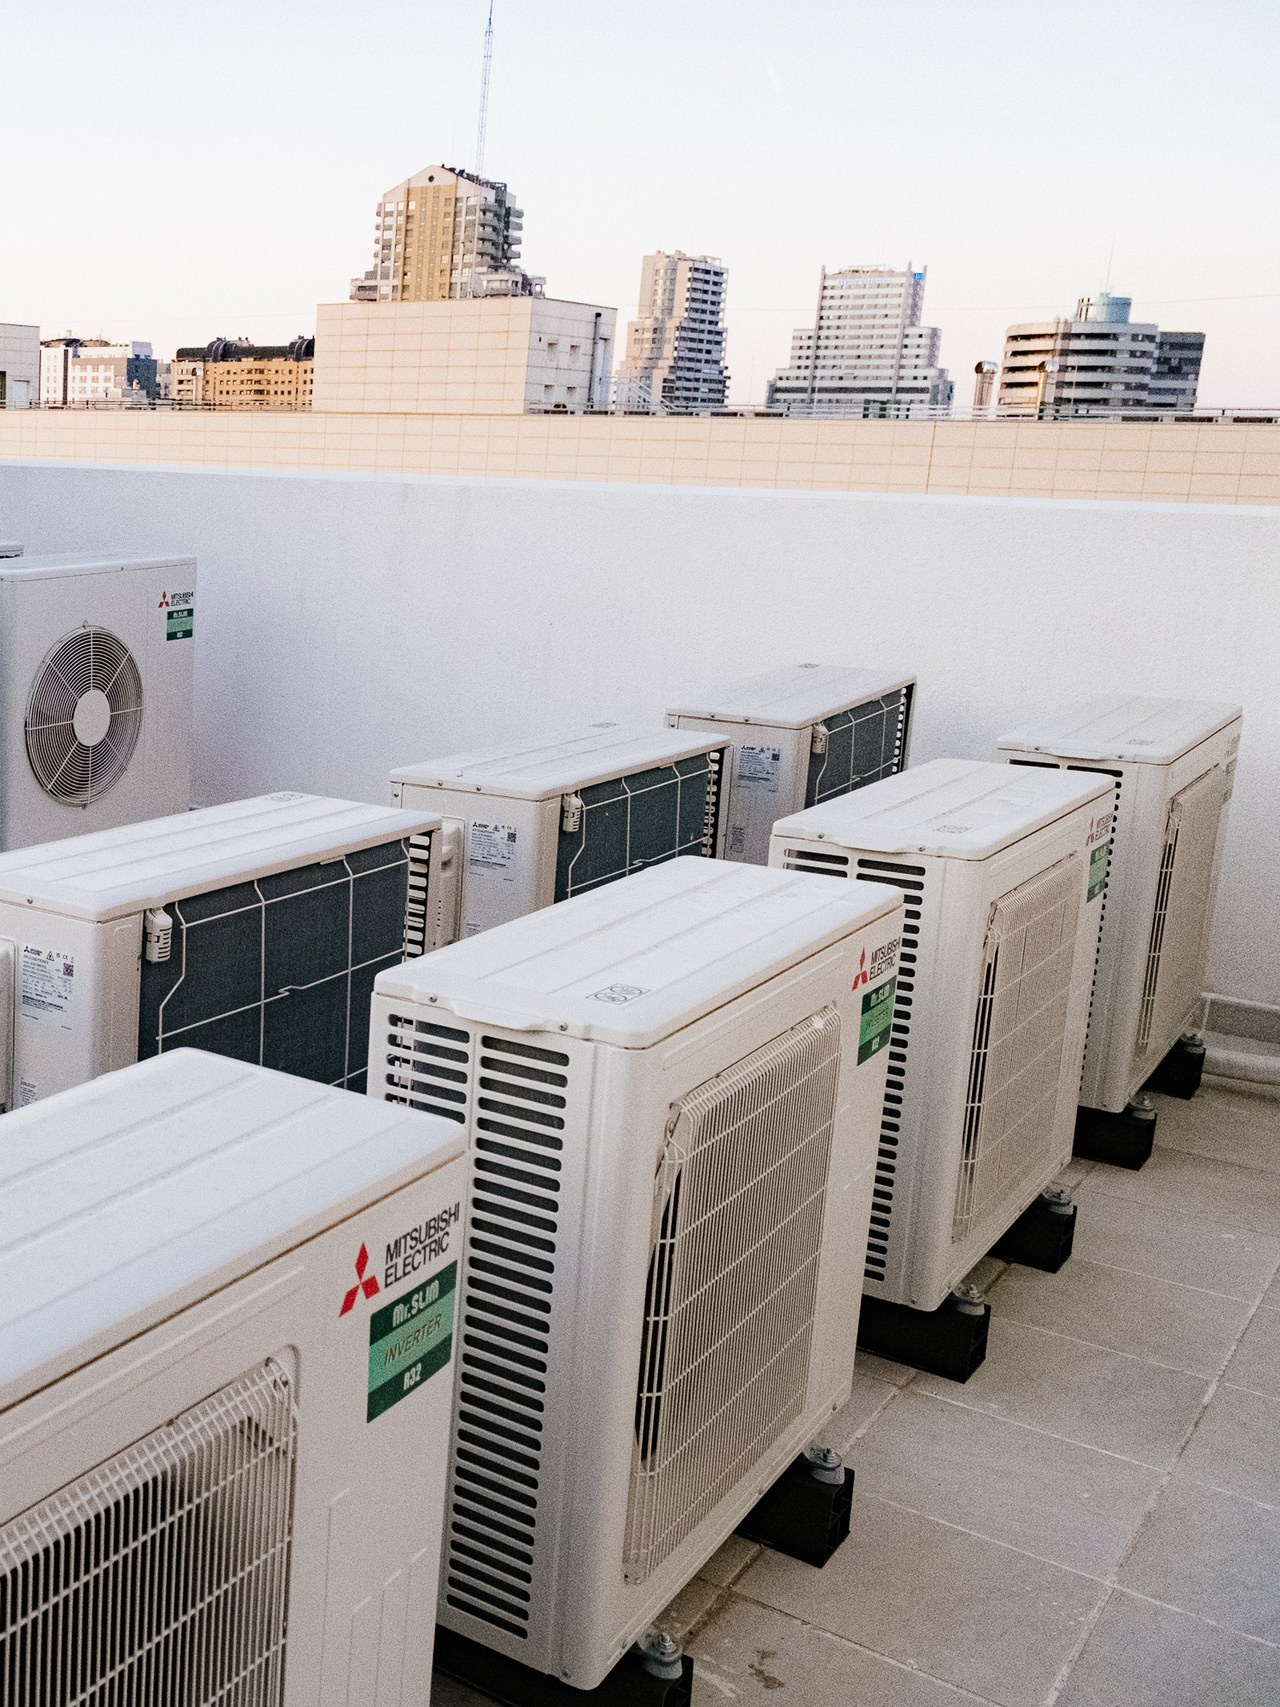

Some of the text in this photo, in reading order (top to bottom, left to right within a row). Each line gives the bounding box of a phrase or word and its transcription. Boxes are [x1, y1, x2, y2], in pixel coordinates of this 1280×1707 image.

[869, 954, 896, 981] ELECTRIC
[385, 1202, 460, 1266] MITSUBISHI
[384, 1231, 450, 1288] ELECTRIC
[392, 1280, 440, 1328] Mr.SLIM
[383, 1313, 443, 1366] INVERTER
[403, 1363, 422, 1391] R32
